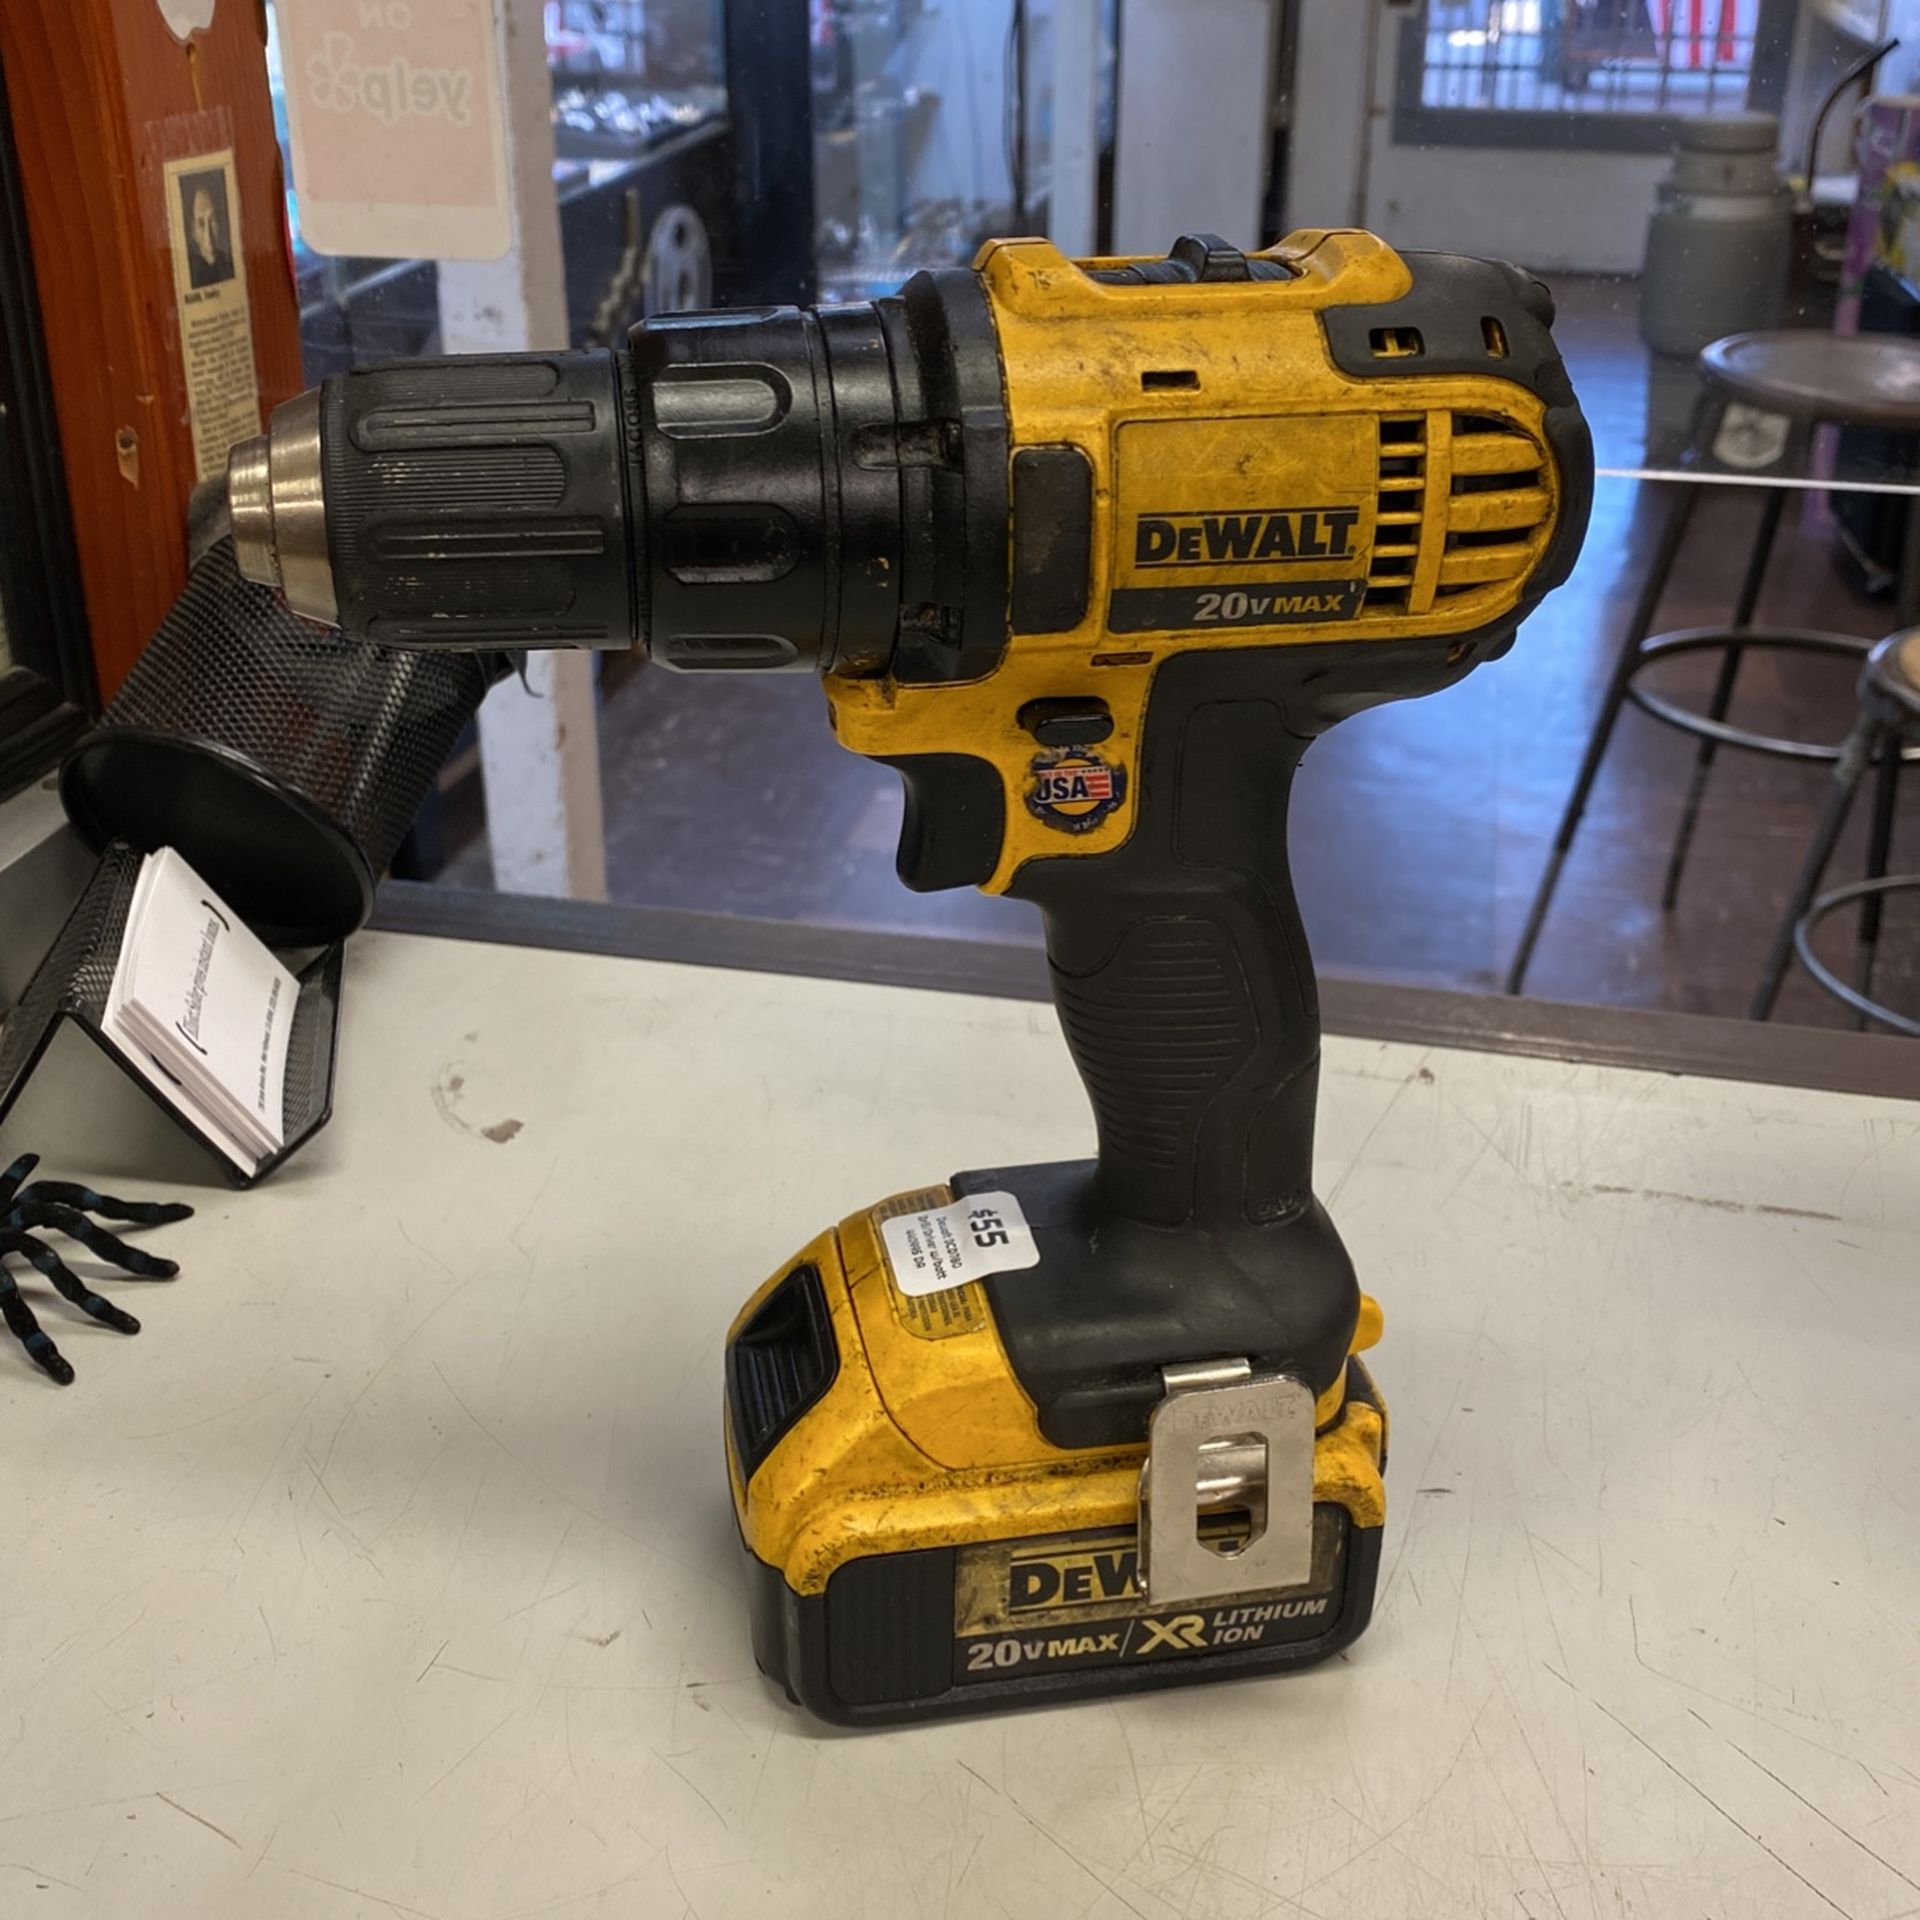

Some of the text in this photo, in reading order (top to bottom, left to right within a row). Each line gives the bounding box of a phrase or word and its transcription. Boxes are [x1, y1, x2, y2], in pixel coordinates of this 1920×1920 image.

[1135, 512, 1358, 562] DEWALT
[1193, 591, 1345, 621] 20V MAX
[968, 1208, 1010, 1248] $55
[1010, 1553, 1141, 1607] DEW
[967, 1598, 1328, 1672] 20V MAX XR LITHIUM
[1212, 1626, 1264, 1645] ION
